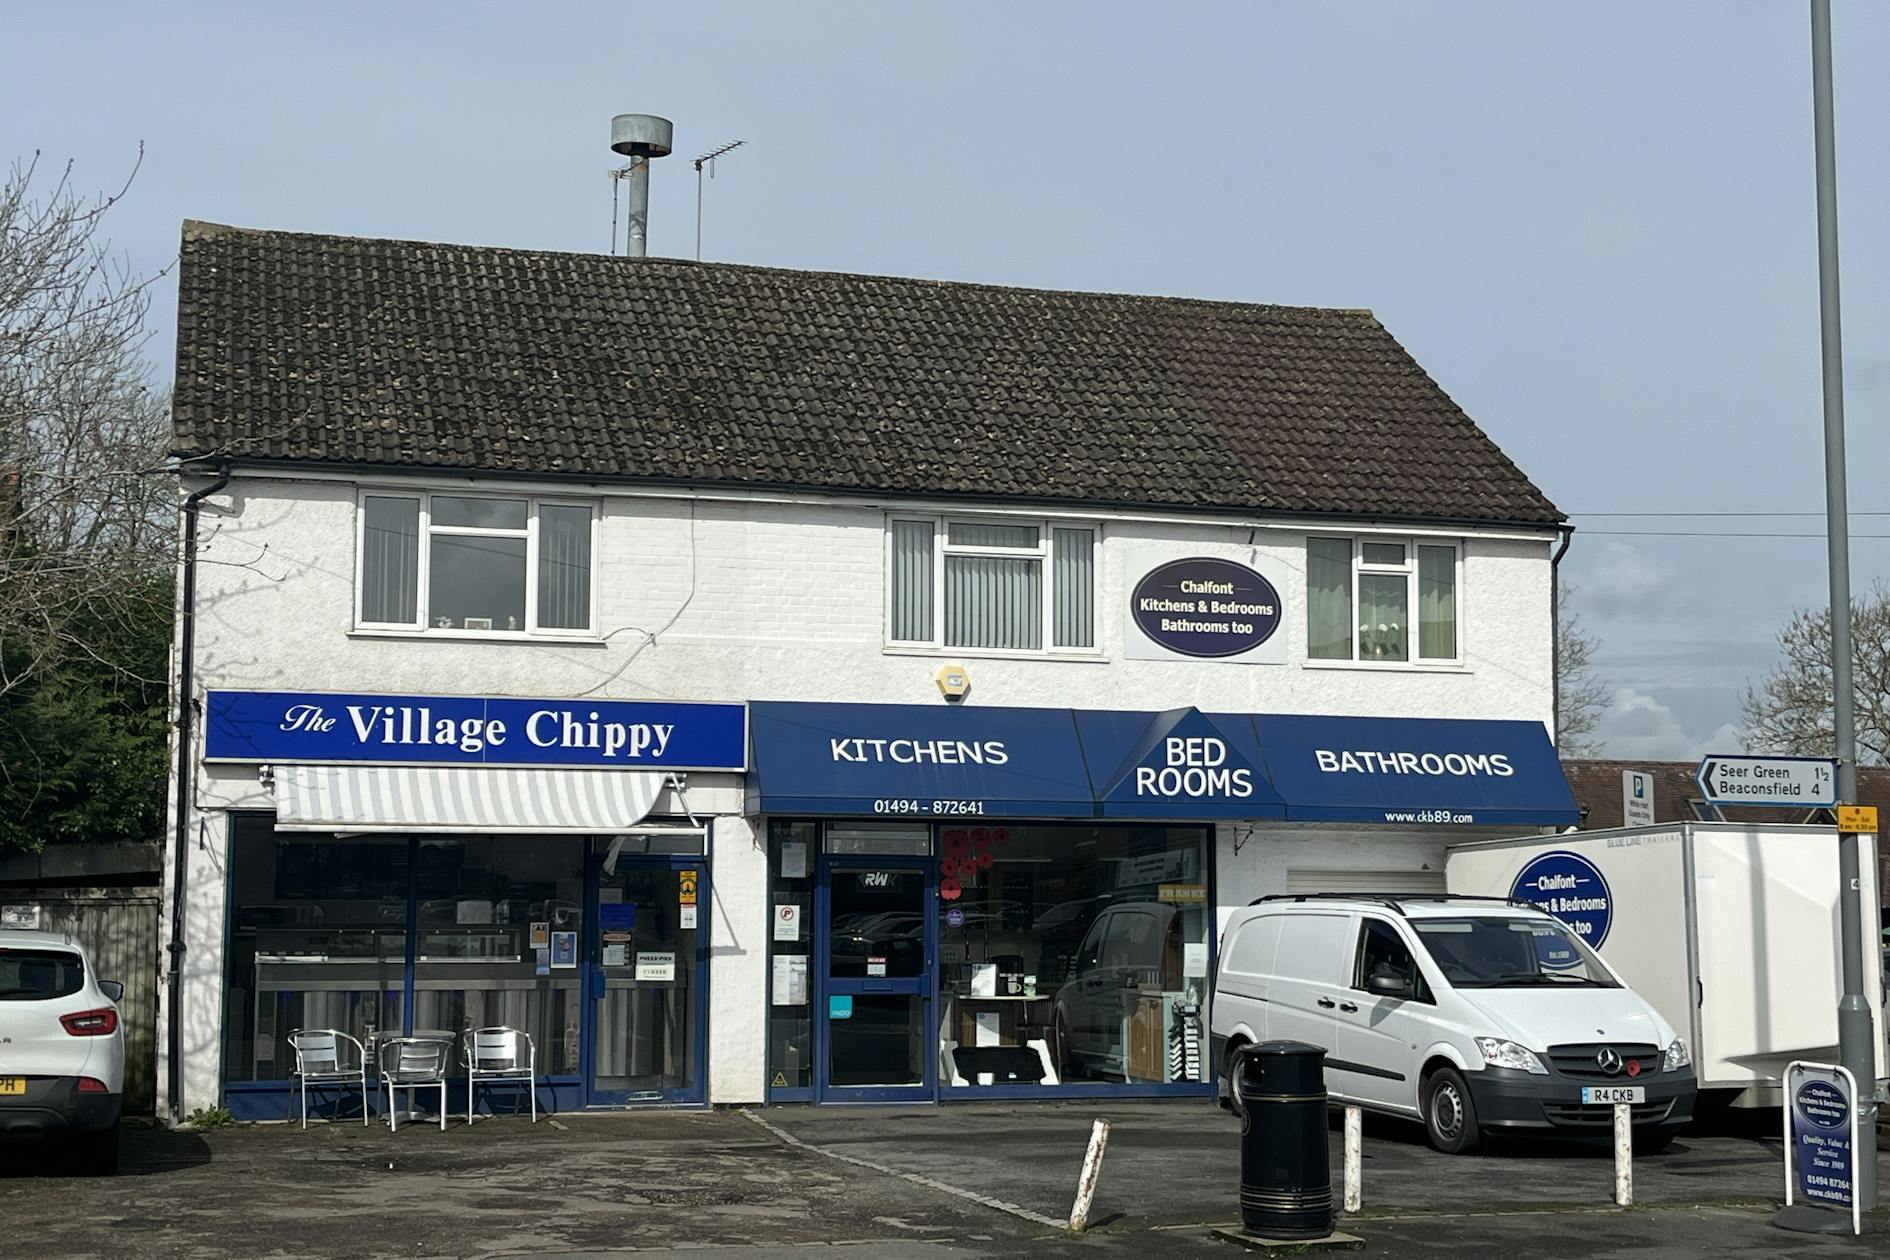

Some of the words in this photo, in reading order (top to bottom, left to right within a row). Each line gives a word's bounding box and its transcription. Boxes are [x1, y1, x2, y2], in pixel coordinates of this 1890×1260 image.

[1180, 580, 1234, 595] Chalfont
[1140, 598, 1195, 613] Kitchens
[1197, 600, 1208, 613] &
[1211, 601, 1274, 616] Bedrooms
[1161, 618, 1230, 634] Bathrooms
[1232, 621, 1254, 635] too
[280, 704, 337, 733] The
[346, 706, 506, 752] Village
[526, 710, 674, 757] Chippy
[830, 738, 1009, 765] KITCHENS
[1166, 737, 1226, 767] BED
[1315, 750, 1514, 777] BATHROOMS
[1719, 764, 1749, 778] Seer
[1753, 765, 1790, 779] Green
[1136, 767, 1253, 797] ROOMS
[1719, 781, 1801, 796] Beaconsfield
[1811, 783, 1820, 796] 4
[873, 800, 919, 814] 01494
[932, 801, 984, 815] 872641
[1385, 810, 1473, 824] www.ckb89.com
[1607, 839, 1625, 848] BLUE
[1626, 836, 1641, 846] LINE
[1538, 874, 1577, 891] Chalfont
[1550, 897, 1559, 912] &
[1560, 896, 1607, 912] Bedrooms
[1575, 920, 1592, 934] too
[1595, 1089, 1609, 1101] R4
[1612, 1089, 1634, 1101] CKB
[1827, 1137, 1843, 1149] Value
[1816, 1147, 1839, 1158] Service
[1813, 1157, 1830, 1168] Since
[1806, 1174, 1828, 1187] 01494
